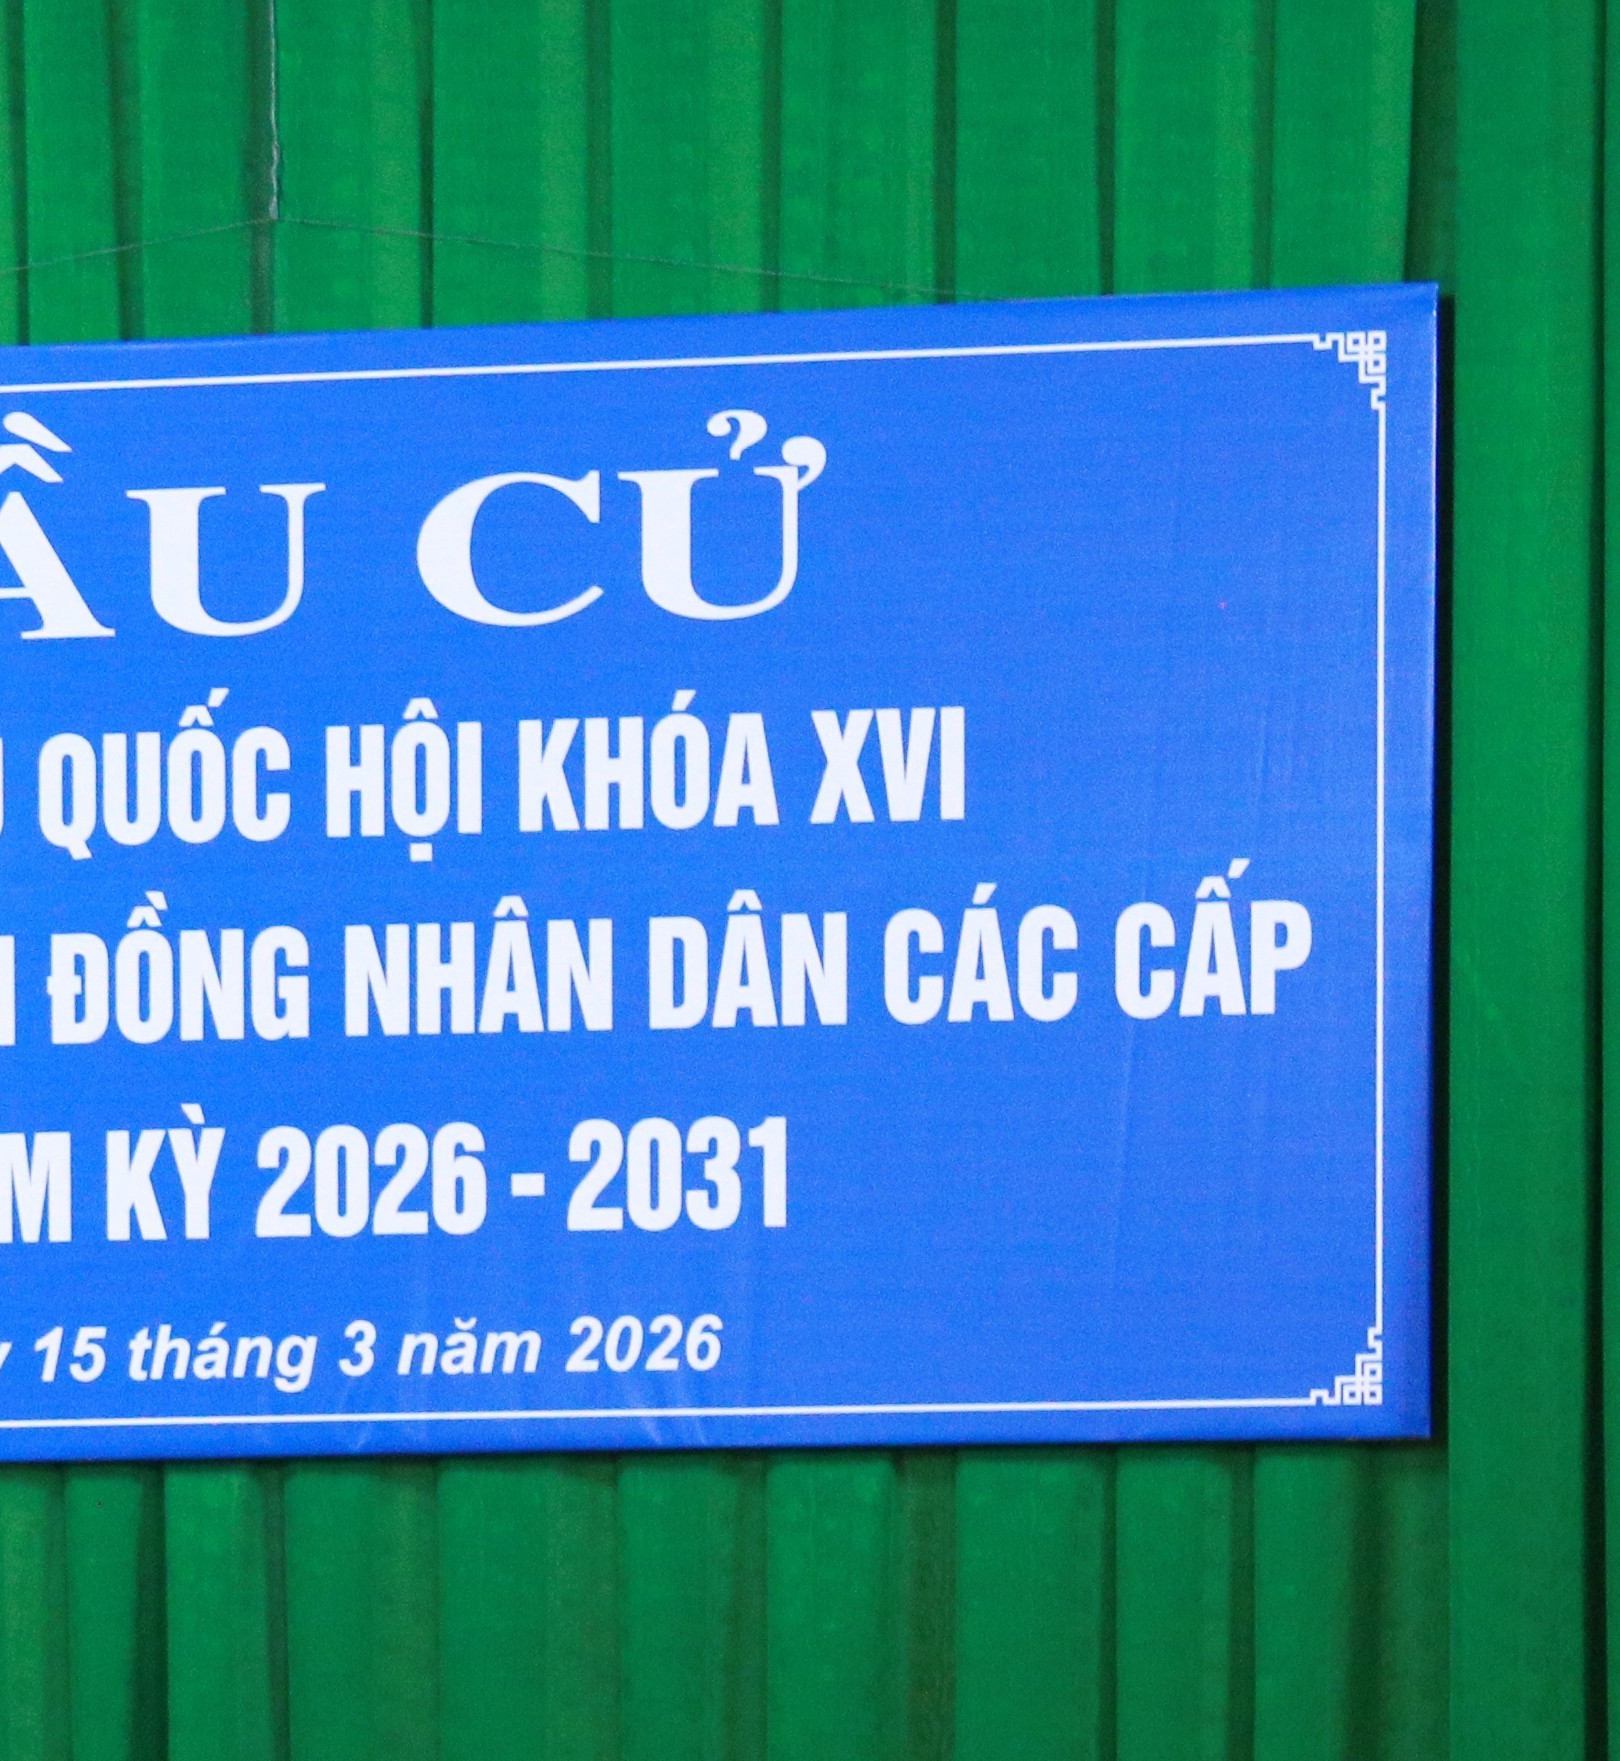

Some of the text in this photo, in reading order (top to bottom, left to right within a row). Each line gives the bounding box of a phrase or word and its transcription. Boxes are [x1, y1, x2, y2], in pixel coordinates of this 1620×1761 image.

[417, 410, 826, 626] CỬ
[39, 688, 290, 860] QUỐC
[326, 698, 482, 861] HỘI
[519, 690, 779, 832] KHÓA
[810, 706, 965, 824] XVI
[47, 891, 309, 1044] ĐỒNG
[345, 896, 613, 1036] NHÂN
[649, 890, 847, 1029] DÂN
[884, 883, 1078, 1024] CÁC
[1115, 858, 1312, 1019] CẤP
[106, 1104, 225, 1240] KỲ
[256, 1122, 487, 1237] 2026
[511, 1173, 545, 1196] -
[567, 1116, 786, 1231] 2031
[35, 1327, 106, 1382] 15
[129, 1322, 317, 1392] tháng
[339, 1320, 376, 1376] 3
[398, 1318, 541, 1375] năm
[566, 1314, 723, 1372] 2026
